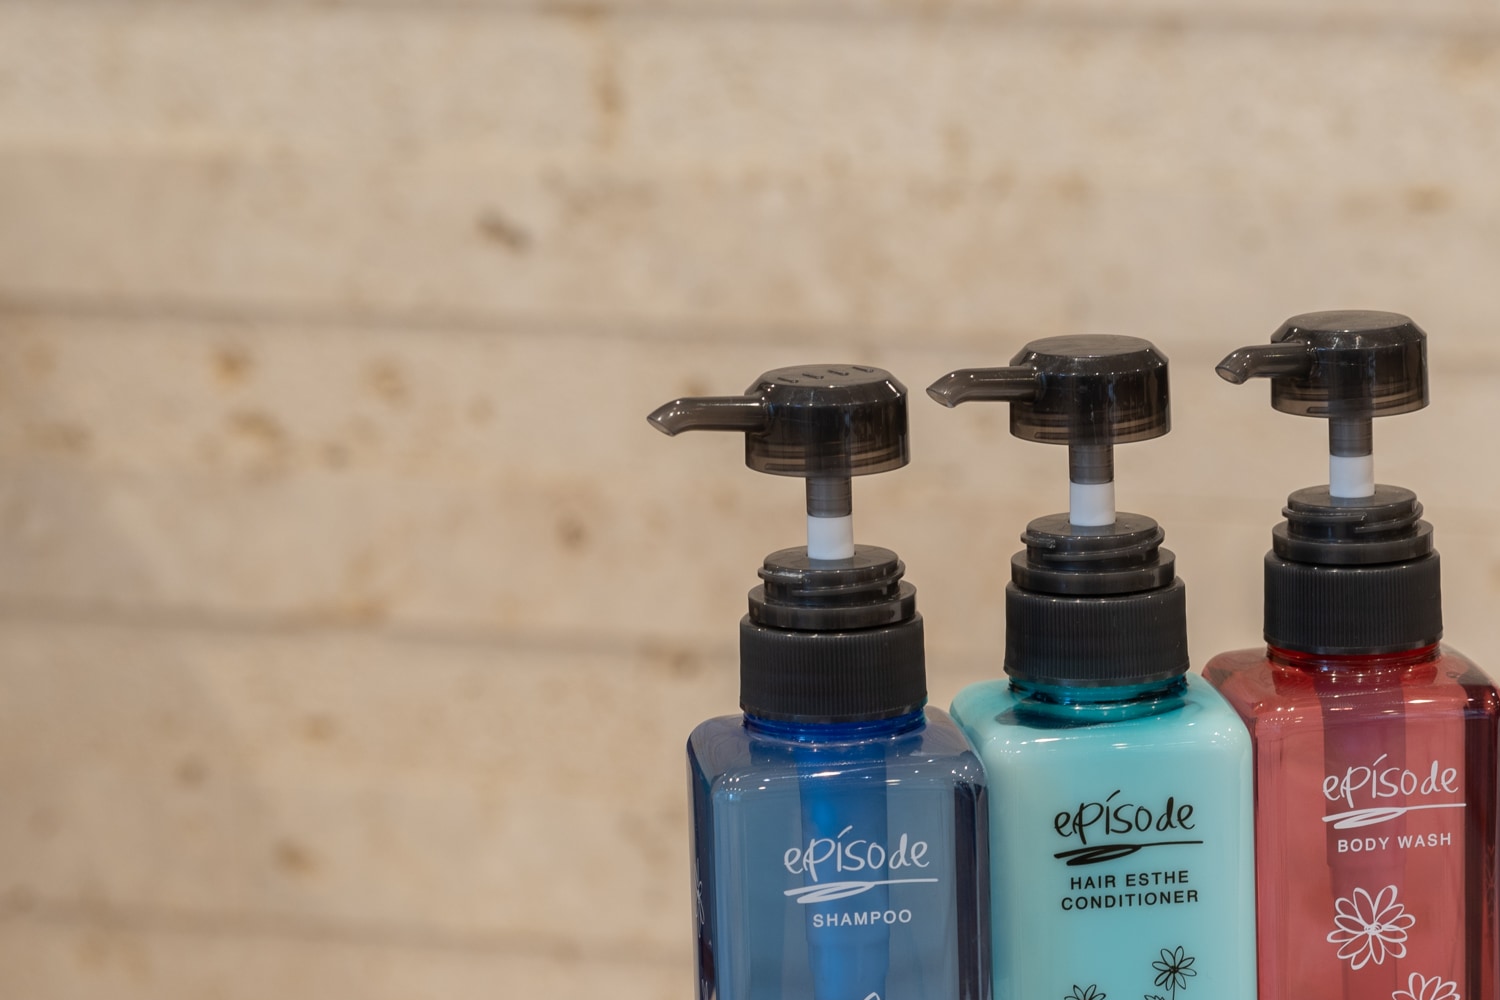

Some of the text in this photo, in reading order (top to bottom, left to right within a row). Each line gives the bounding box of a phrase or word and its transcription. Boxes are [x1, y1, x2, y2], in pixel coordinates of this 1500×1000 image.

[1337, 832, 1452, 853] BODY WASH
[1070, 870, 1190, 890] HAIR ESTHE
[1061, 889, 1199, 911] CONDITIONER
[812, 909, 912, 928] SHAMPOO
